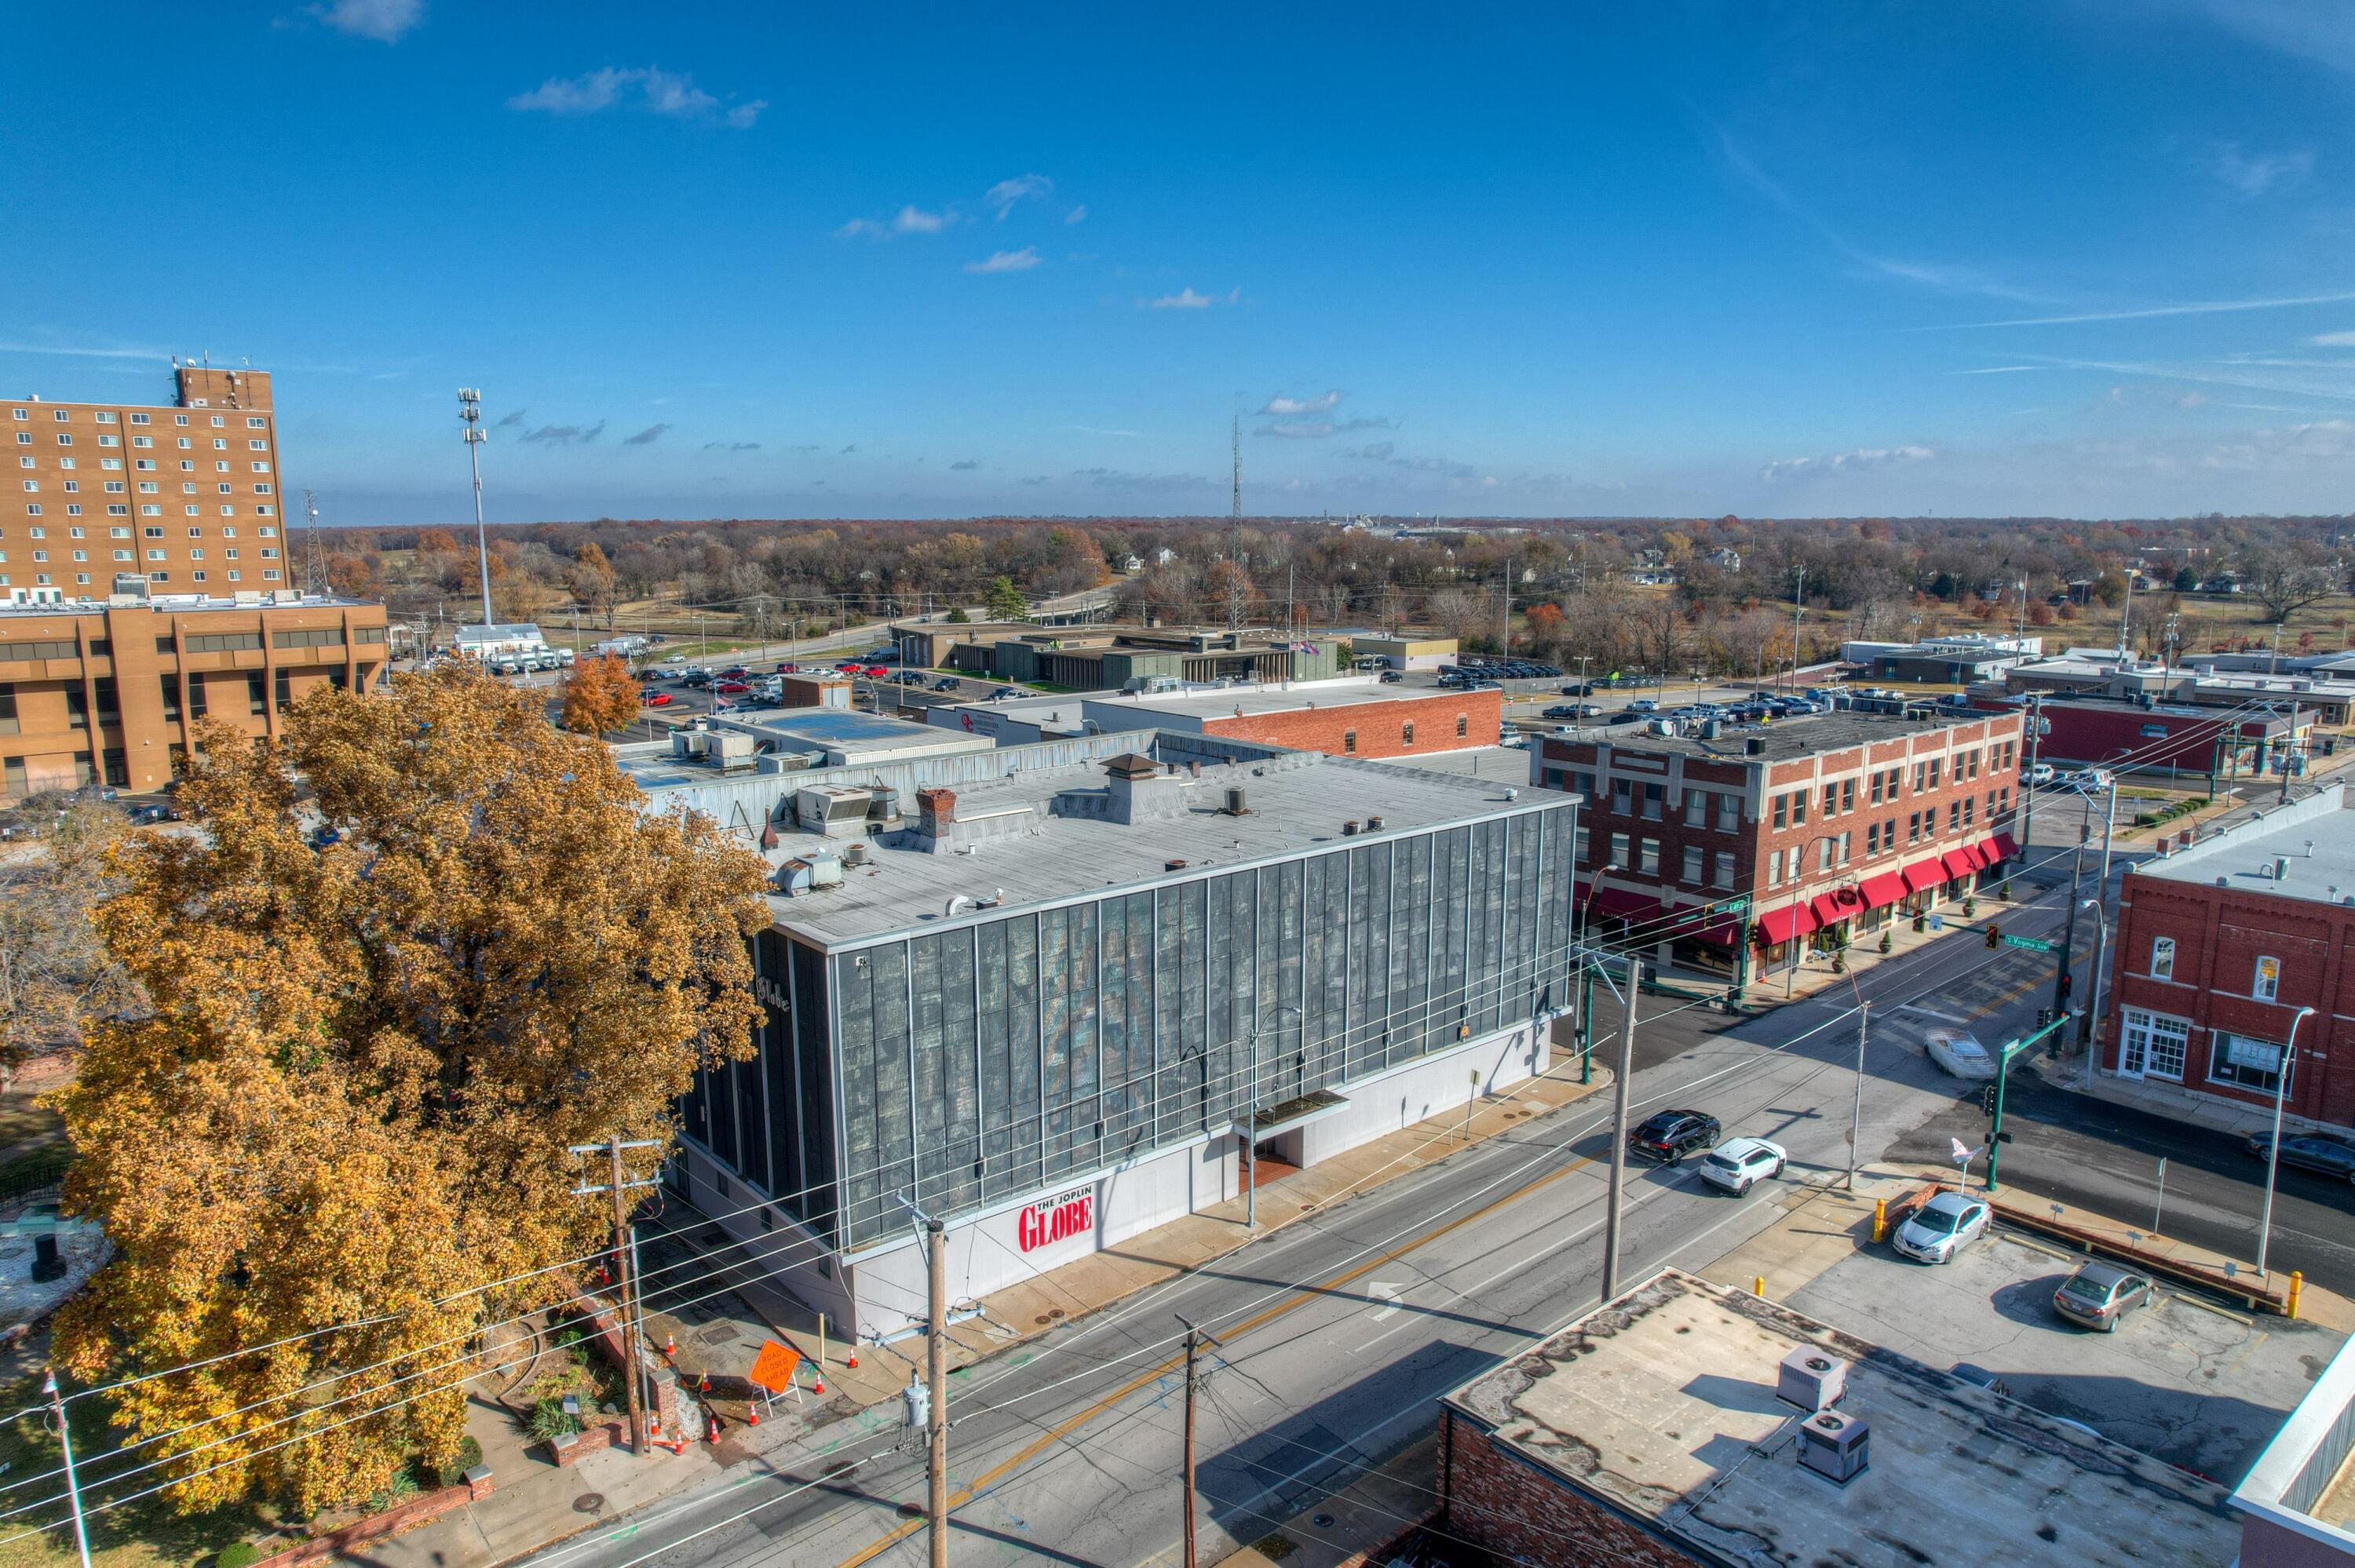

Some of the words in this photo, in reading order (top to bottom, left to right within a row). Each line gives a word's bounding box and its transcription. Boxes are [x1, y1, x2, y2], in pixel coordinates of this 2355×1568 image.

[2014, 936, 2035, 948] Virginia
[756, 976, 790, 1012] Globe
[1037, 1198, 1055, 1211] THE
[1058, 1186, 1092, 1205] JOPLIN
[761, 1350, 781, 1363] ROAD
[761, 1358, 788, 1375] CLOSED
[765, 1368, 789, 1384] AHEAD
